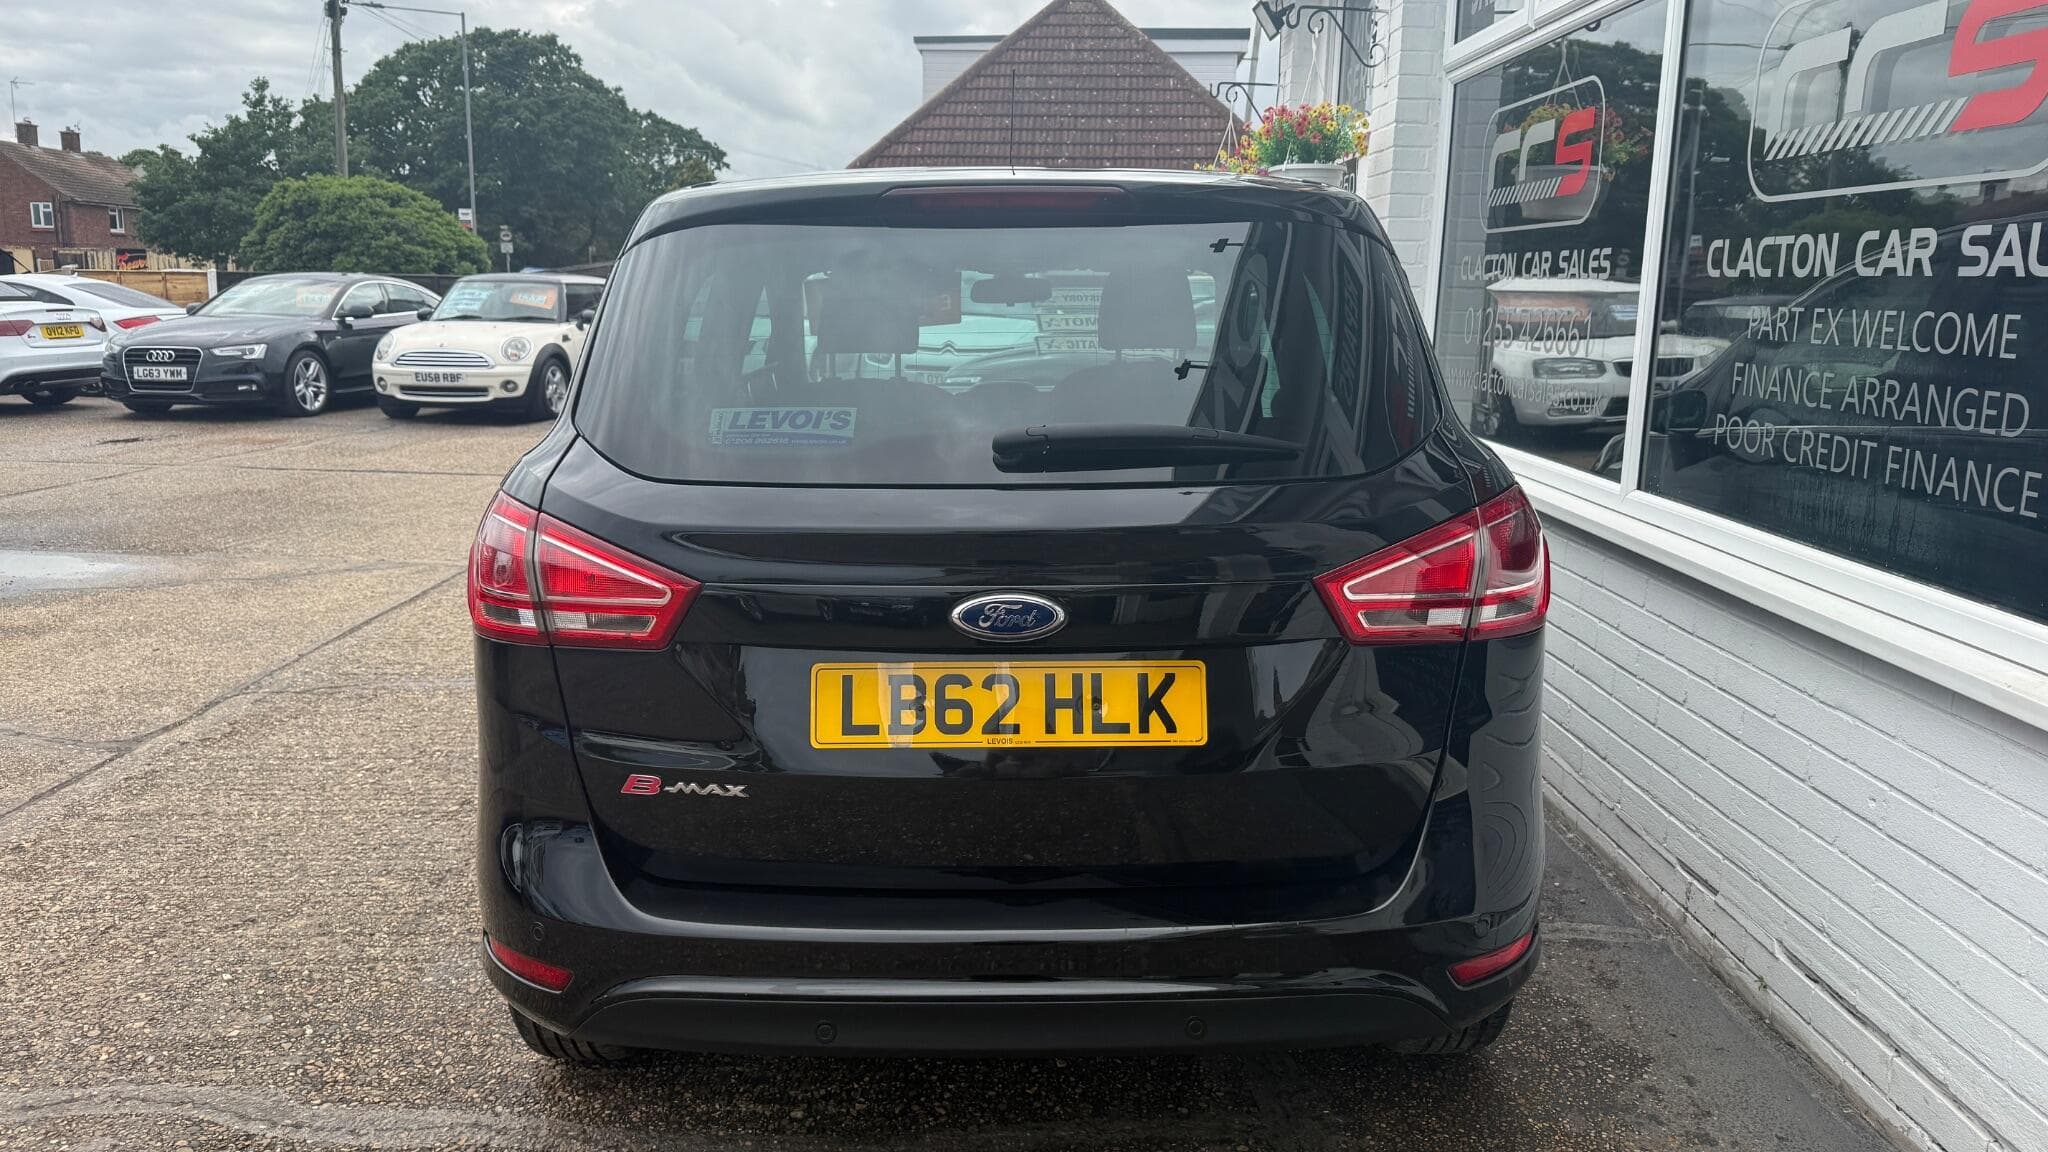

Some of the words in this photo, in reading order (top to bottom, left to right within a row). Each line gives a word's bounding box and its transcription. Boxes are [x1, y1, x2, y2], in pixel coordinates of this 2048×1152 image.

[1460, 252, 1517, 281] CLACTON
[1522, 251, 1553, 280] CAR
[1558, 248, 1613, 280] SALES
[1707, 233, 1840, 279] CLACTON
[1856, 228, 1938, 277] CAR
[1958, 222, 2048, 278] SAL
[1464, 307, 1514, 350] 01255
[1518, 309, 1594, 358] 426661
[1747, 306, 1805, 342] PART
[1810, 308, 1844, 346] EX
[1852, 309, 2022, 359] WELCOME
[136, 368, 161, 378] LG63
[415, 372, 441, 383] EU58
[442, 372, 463, 383] RBF
[1731, 362, 1836, 410] FINANCE
[1840, 375, 2030, 438] ARRANGED
[728, 410, 852, 430] LEVOI'S
[1714, 413, 1775, 458] POOR
[1783, 427, 1878, 480] CREDIT
[1885, 445, 2043, 519] FINANCE
[978, 603, 1038, 628] Ford
[841, 672, 1021, 737] LB62
[1044, 672, 1178, 736] HLK
[986, 737, 1014, 745] LEVOIS
[620, 774, 749, 798] B-MAX
